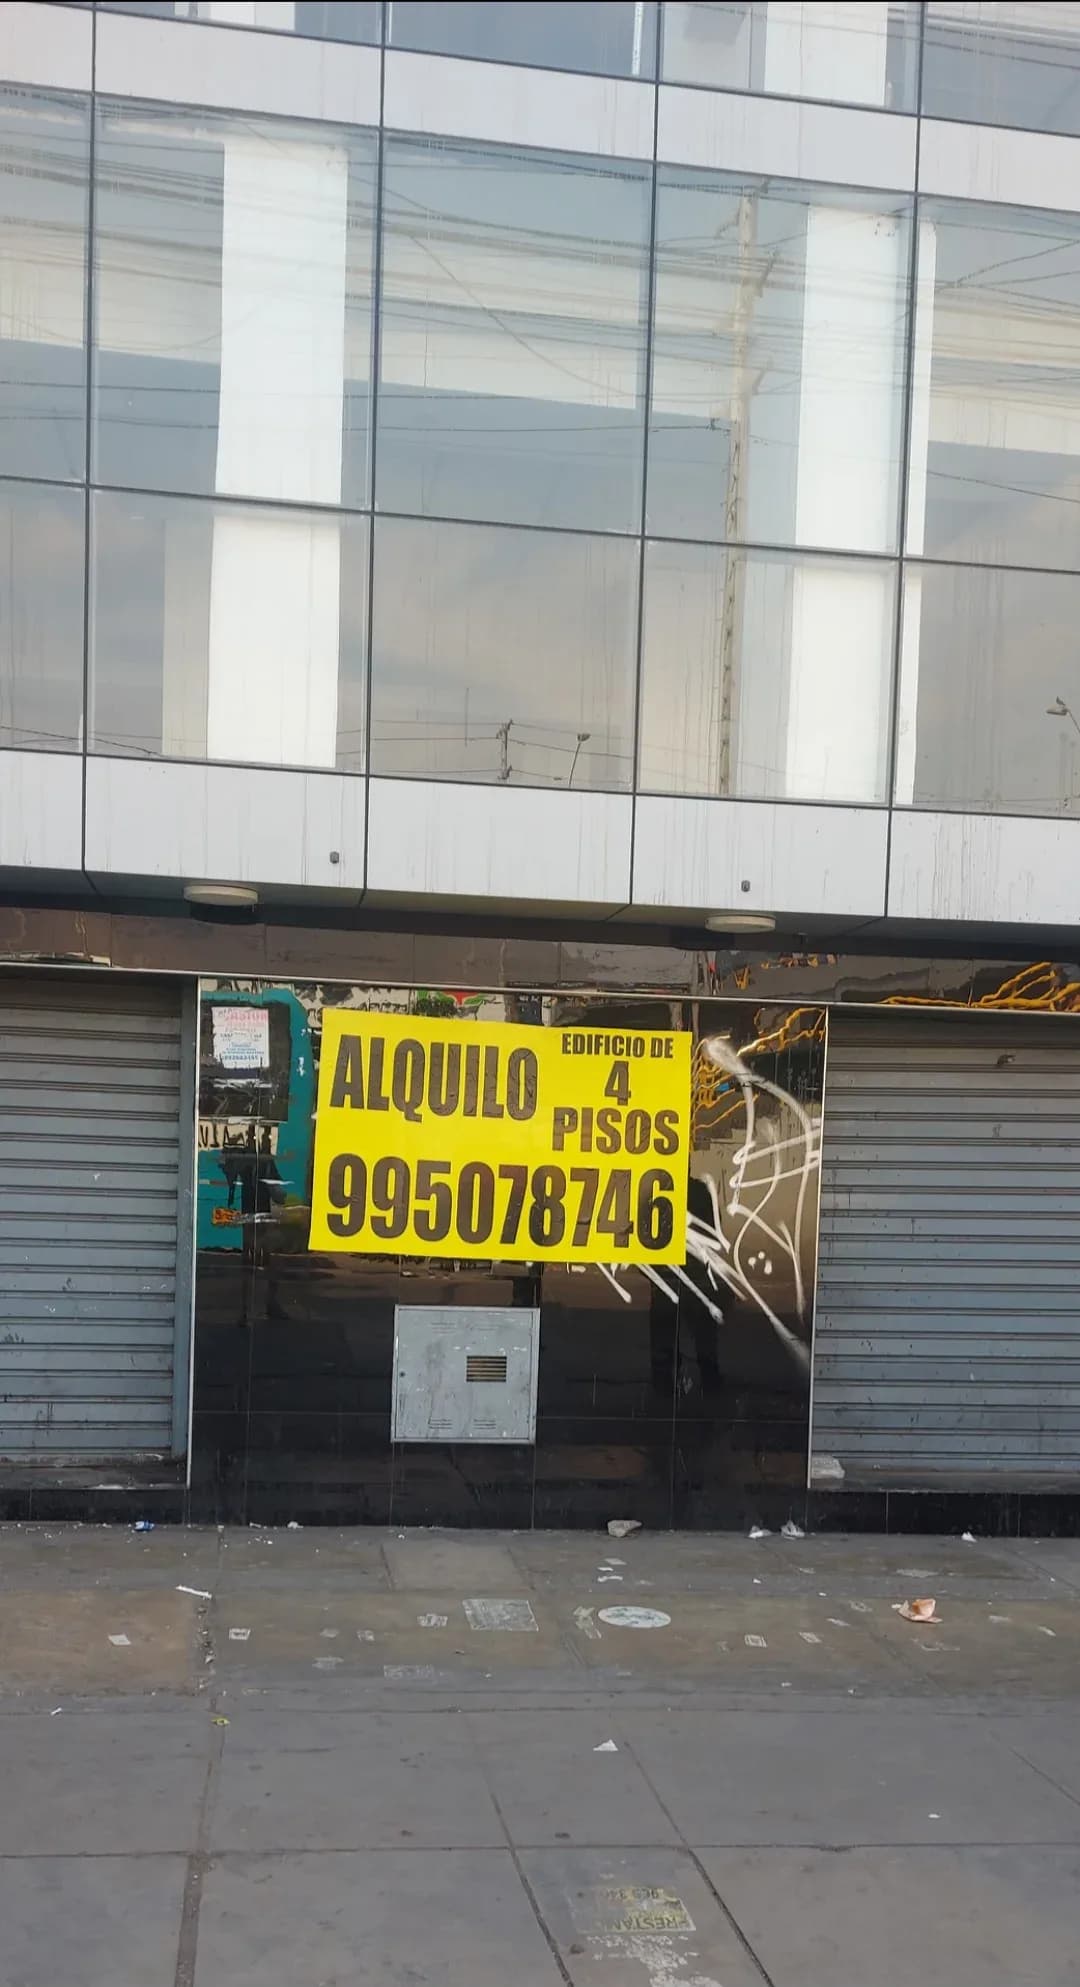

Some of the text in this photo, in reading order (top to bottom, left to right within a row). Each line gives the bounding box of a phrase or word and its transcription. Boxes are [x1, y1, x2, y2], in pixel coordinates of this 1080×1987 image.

[562, 1033, 674, 1059] EDIFICIO DE
[330, 1033, 538, 1122] ALQUILO
[604, 1060, 631, 1106] 4
[552, 1107, 680, 1155] PISOS
[327, 1153, 675, 1250] 995078746
